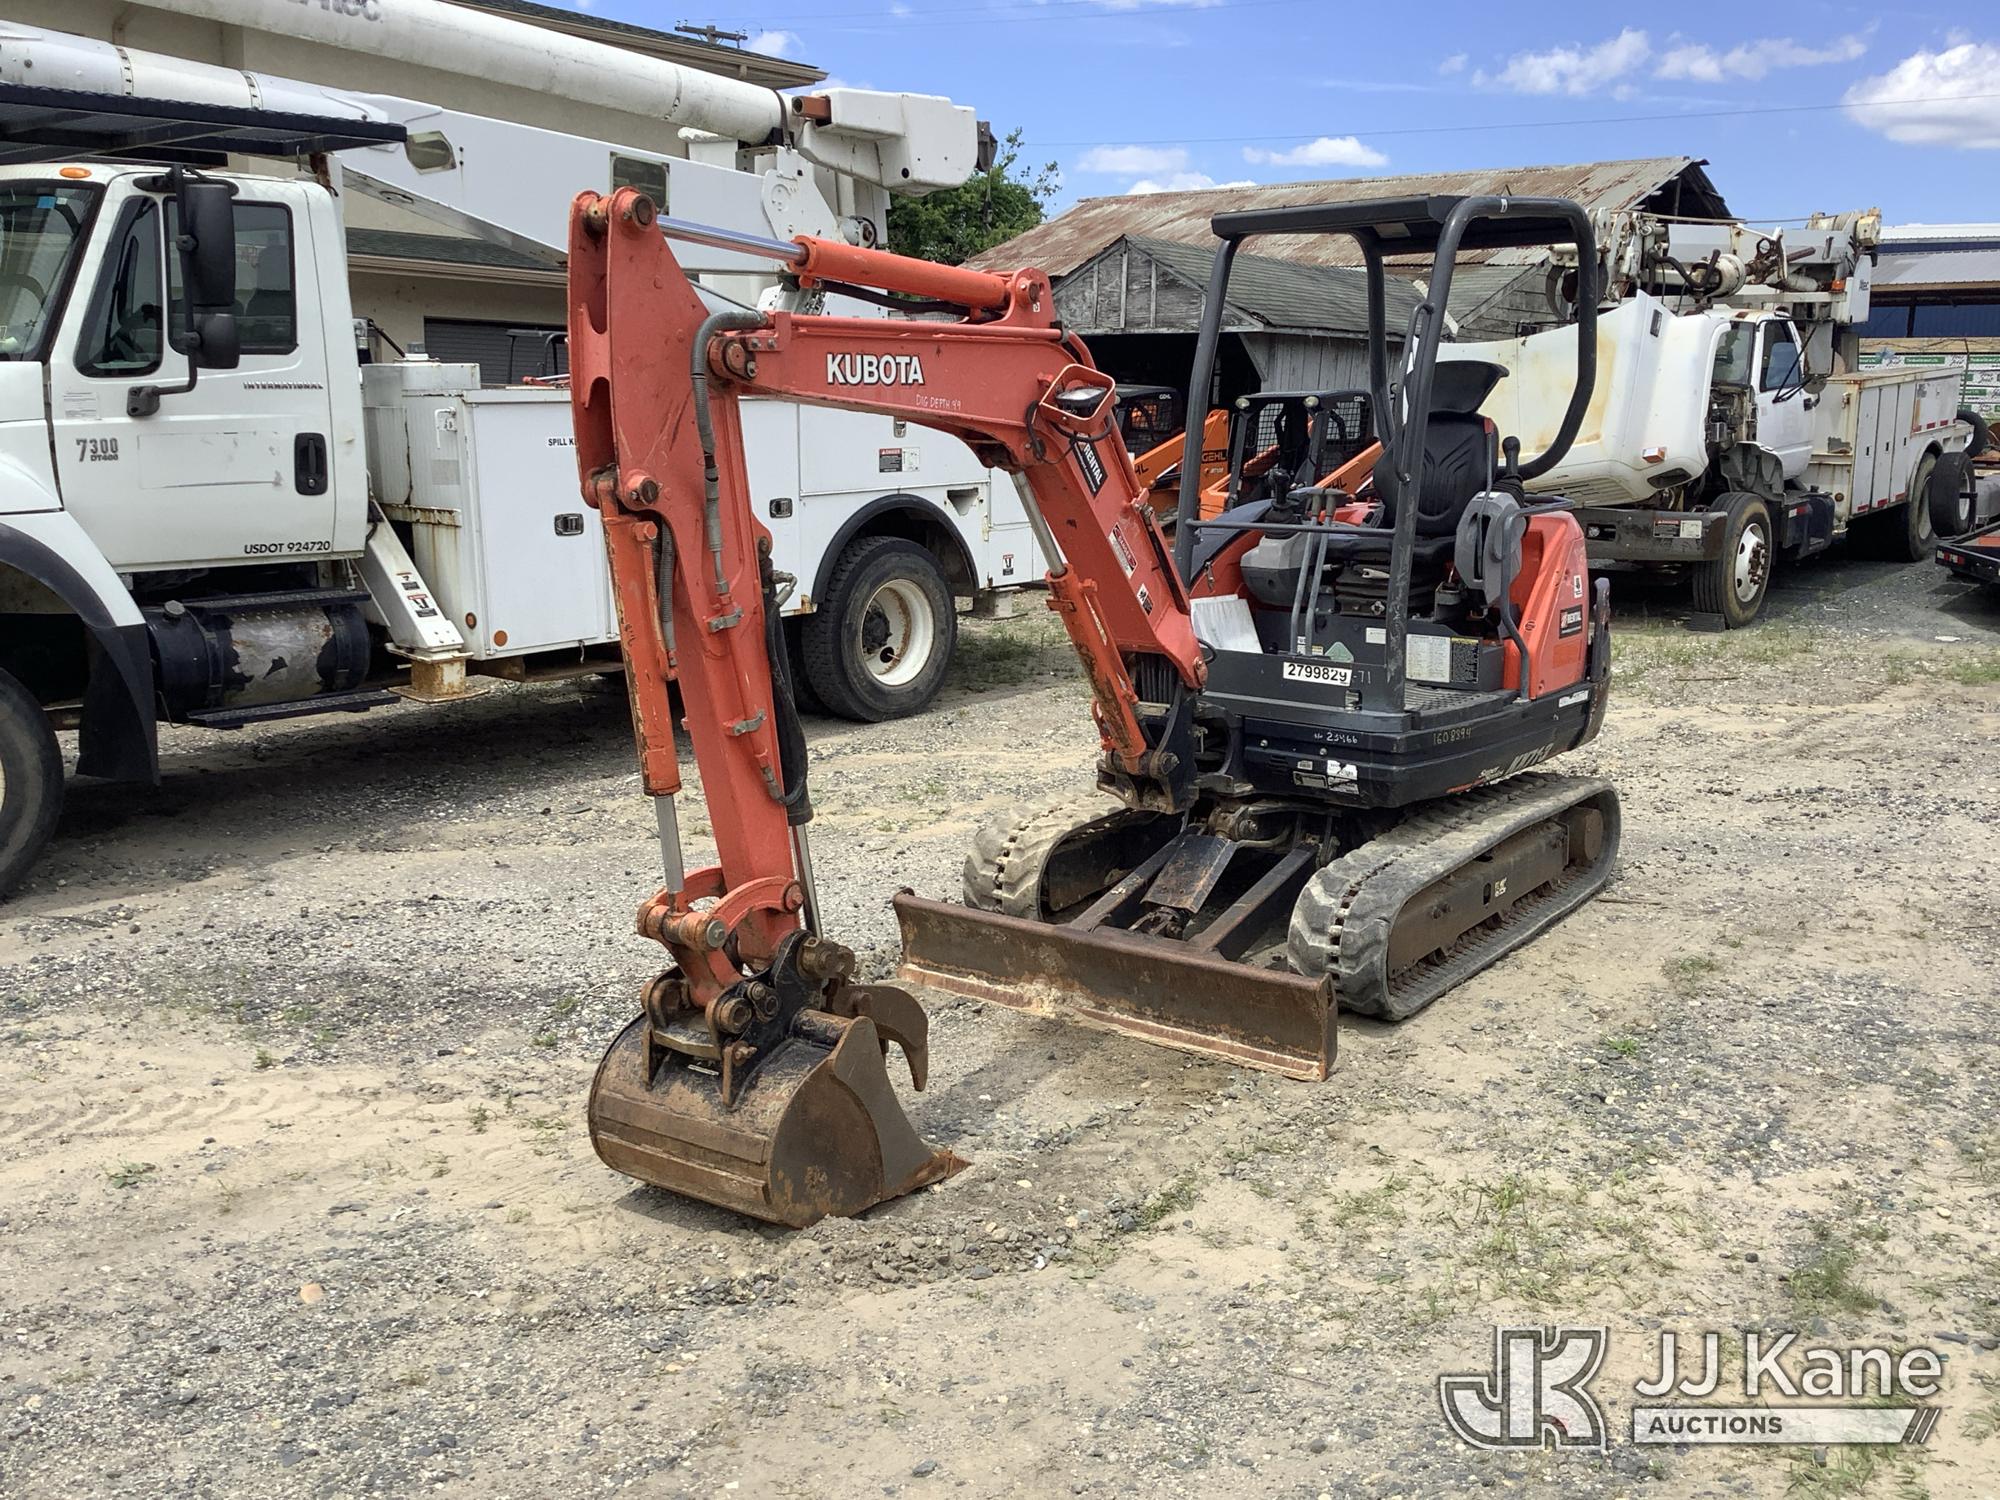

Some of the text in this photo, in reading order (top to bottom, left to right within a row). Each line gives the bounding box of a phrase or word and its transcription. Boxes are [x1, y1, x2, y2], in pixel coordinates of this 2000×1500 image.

[827, 352, 925, 386] KUBOTA
[243, 382, 324, 390] INTERNATIONAL
[548, 438, 577, 446] SPILL KI
[76, 438, 119, 462] 7300
[1202, 451, 1226, 462] GEHL
[1083, 443, 1103, 485] RENTAL
[244, 541, 331, 554] USDOT 924720
